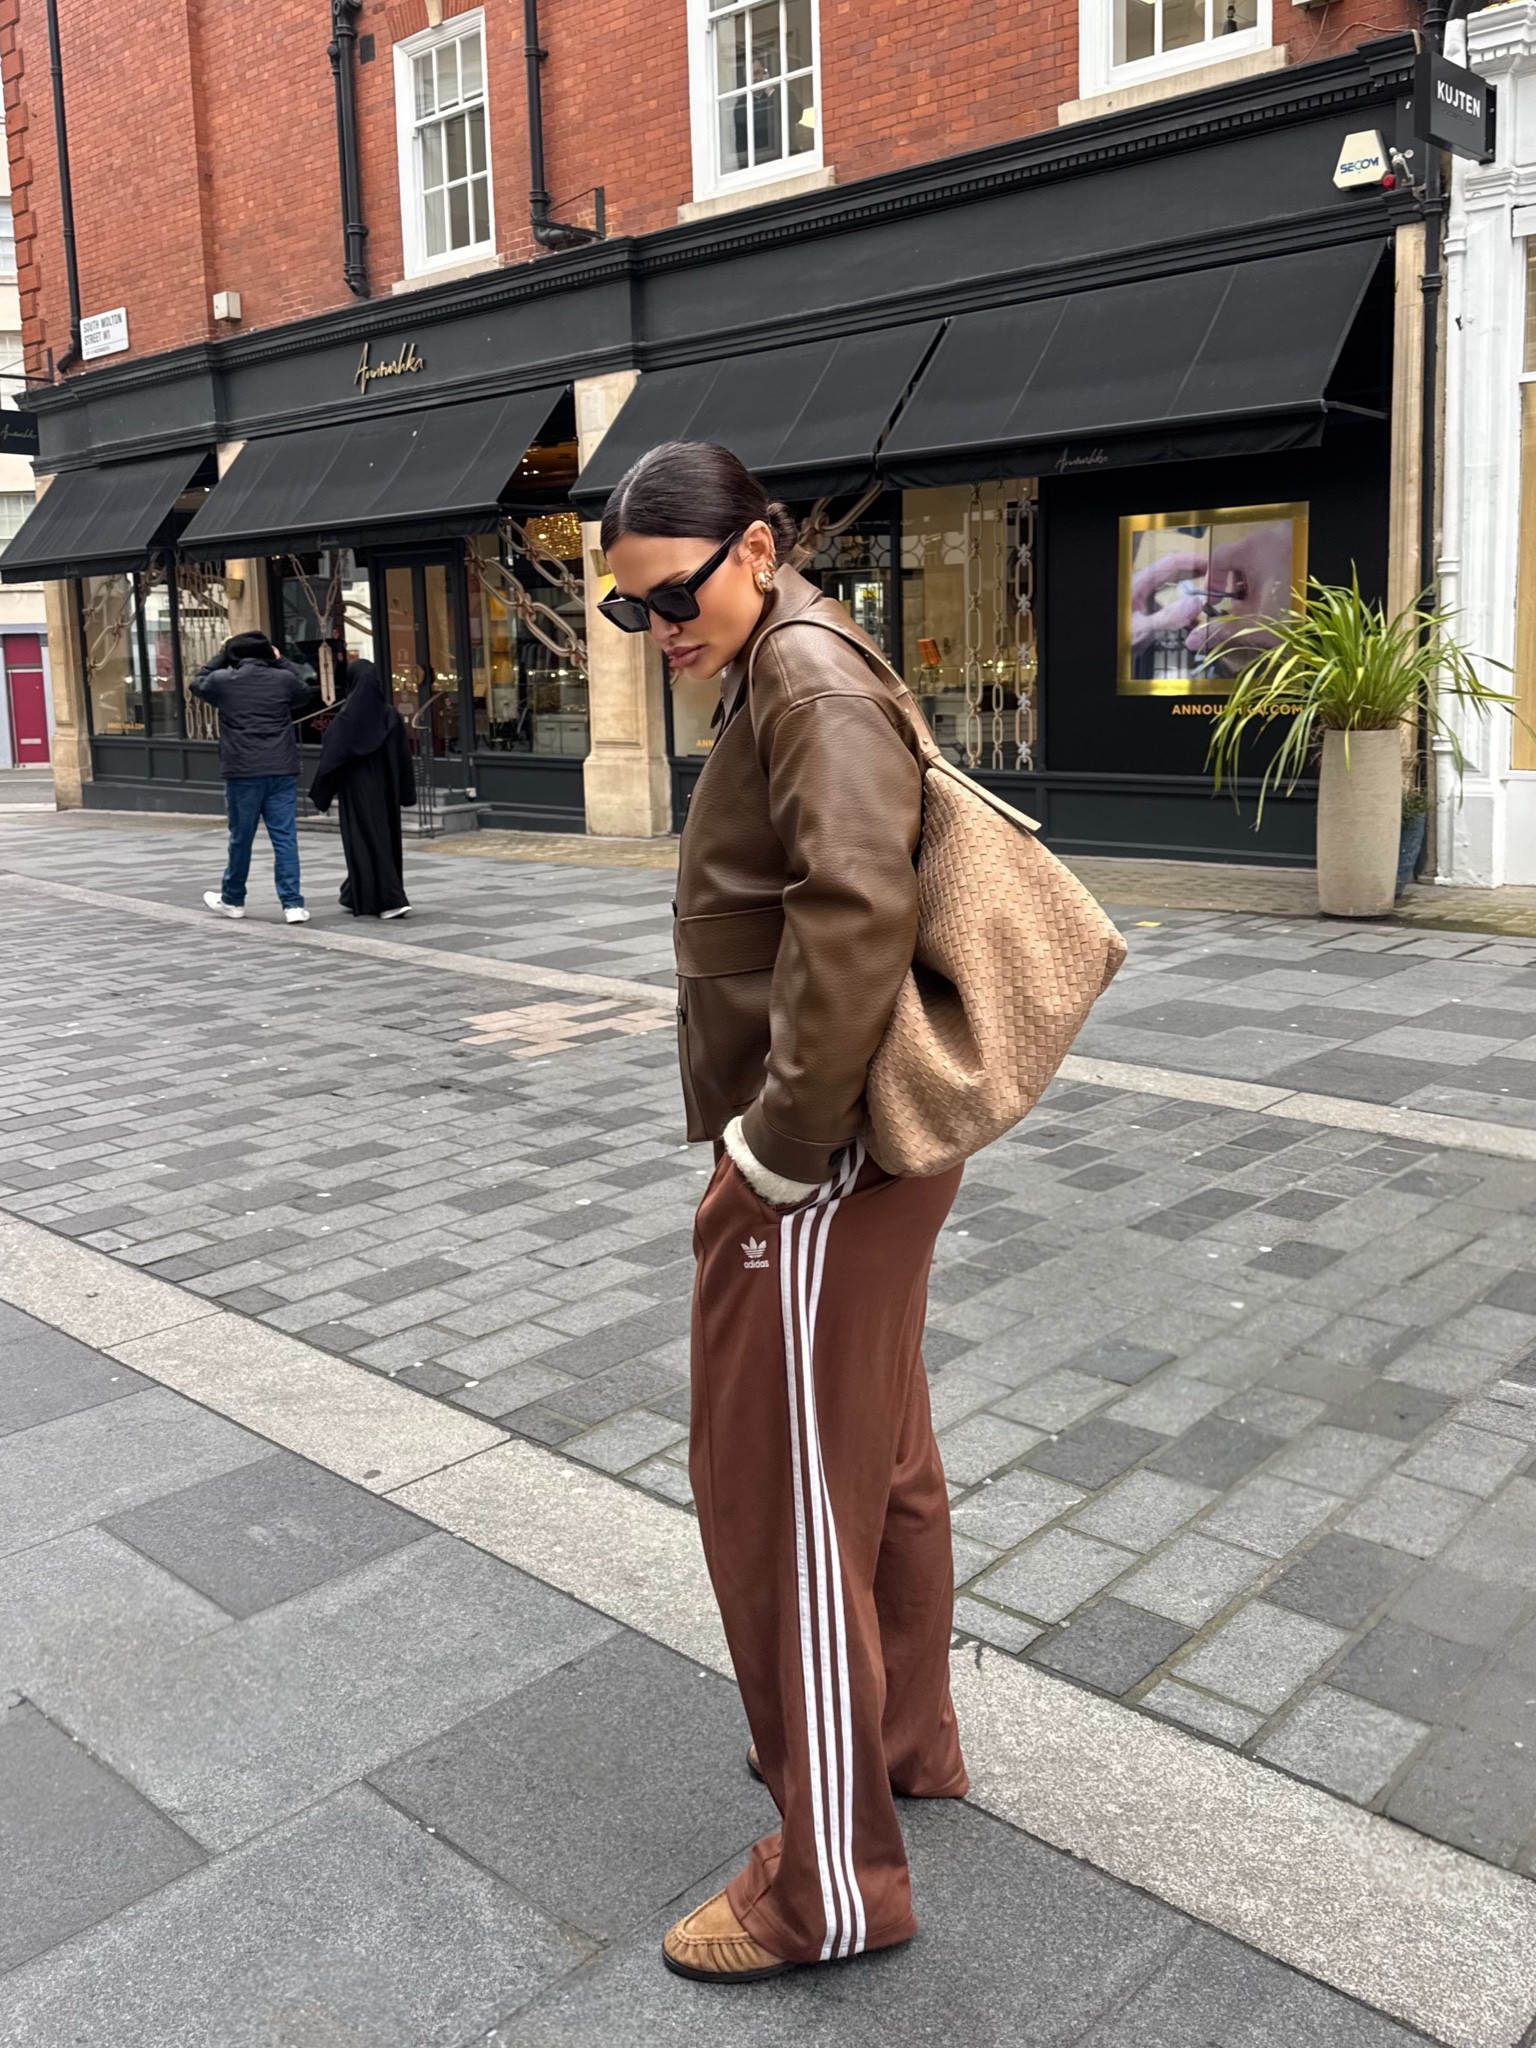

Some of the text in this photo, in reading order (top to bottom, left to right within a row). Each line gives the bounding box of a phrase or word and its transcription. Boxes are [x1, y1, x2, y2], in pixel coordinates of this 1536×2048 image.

[1437, 80, 1480, 118] KUJTEN
[1340, 156, 1379, 174] SECOM
[83, 313, 122, 333] SOUTH MOLTON
[84, 331, 101, 346] STREET
[743, 1260, 770, 1269] adidas
